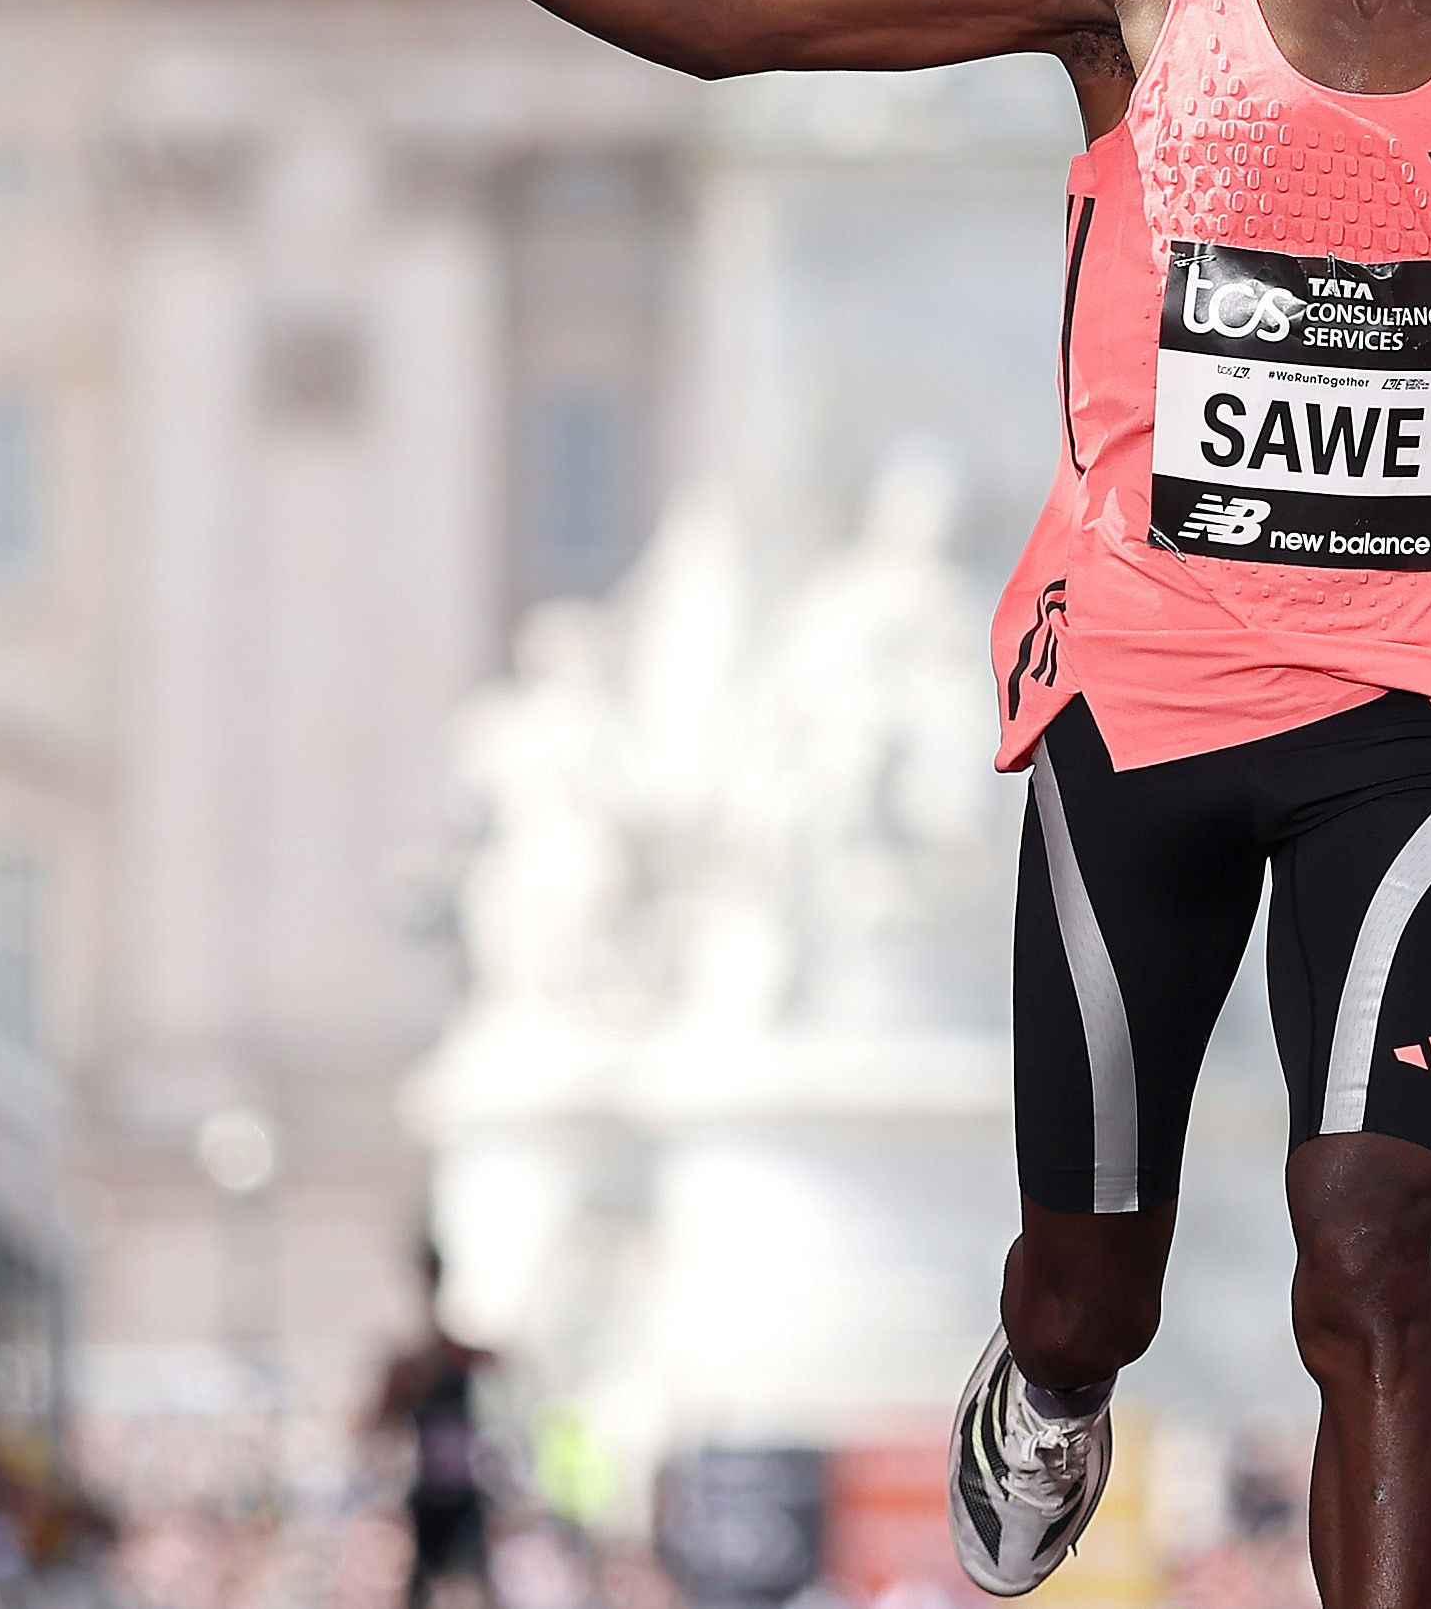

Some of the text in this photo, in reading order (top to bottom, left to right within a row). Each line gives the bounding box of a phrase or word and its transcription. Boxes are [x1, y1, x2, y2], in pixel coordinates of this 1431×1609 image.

[1308, 277, 1374, 301] TATA
[1183, 263, 1292, 341] tcs
[1303, 327, 1404, 350] SERVICES
[1201, 392, 1425, 478] SAWE
[1270, 530, 1431, 555] new balance
